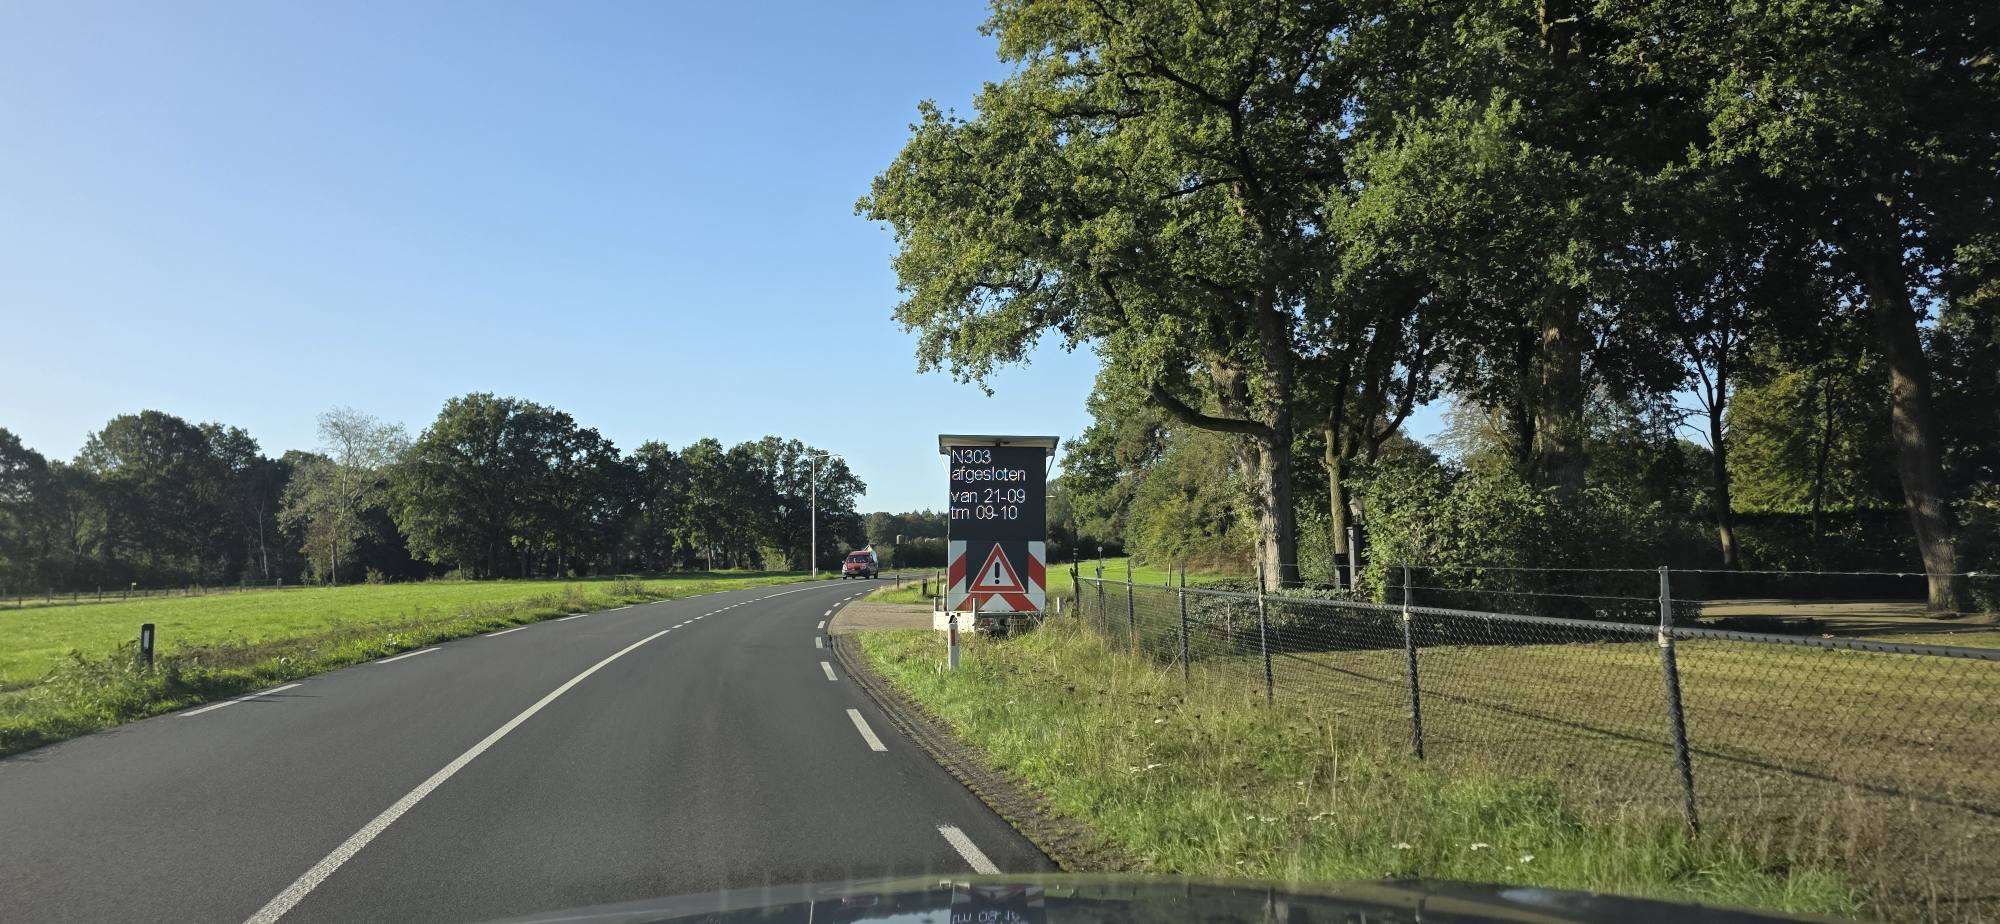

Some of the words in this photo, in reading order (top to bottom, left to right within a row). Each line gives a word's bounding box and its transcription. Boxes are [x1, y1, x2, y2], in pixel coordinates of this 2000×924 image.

[952, 449, 992, 464] N303
[951, 466, 1026, 484] afgesloten
[951, 491, 978, 503] van
[984, 488, 1026, 504] 21-09
[951, 505, 970, 520] tm
[976, 505, 1018, 520] 09-10
